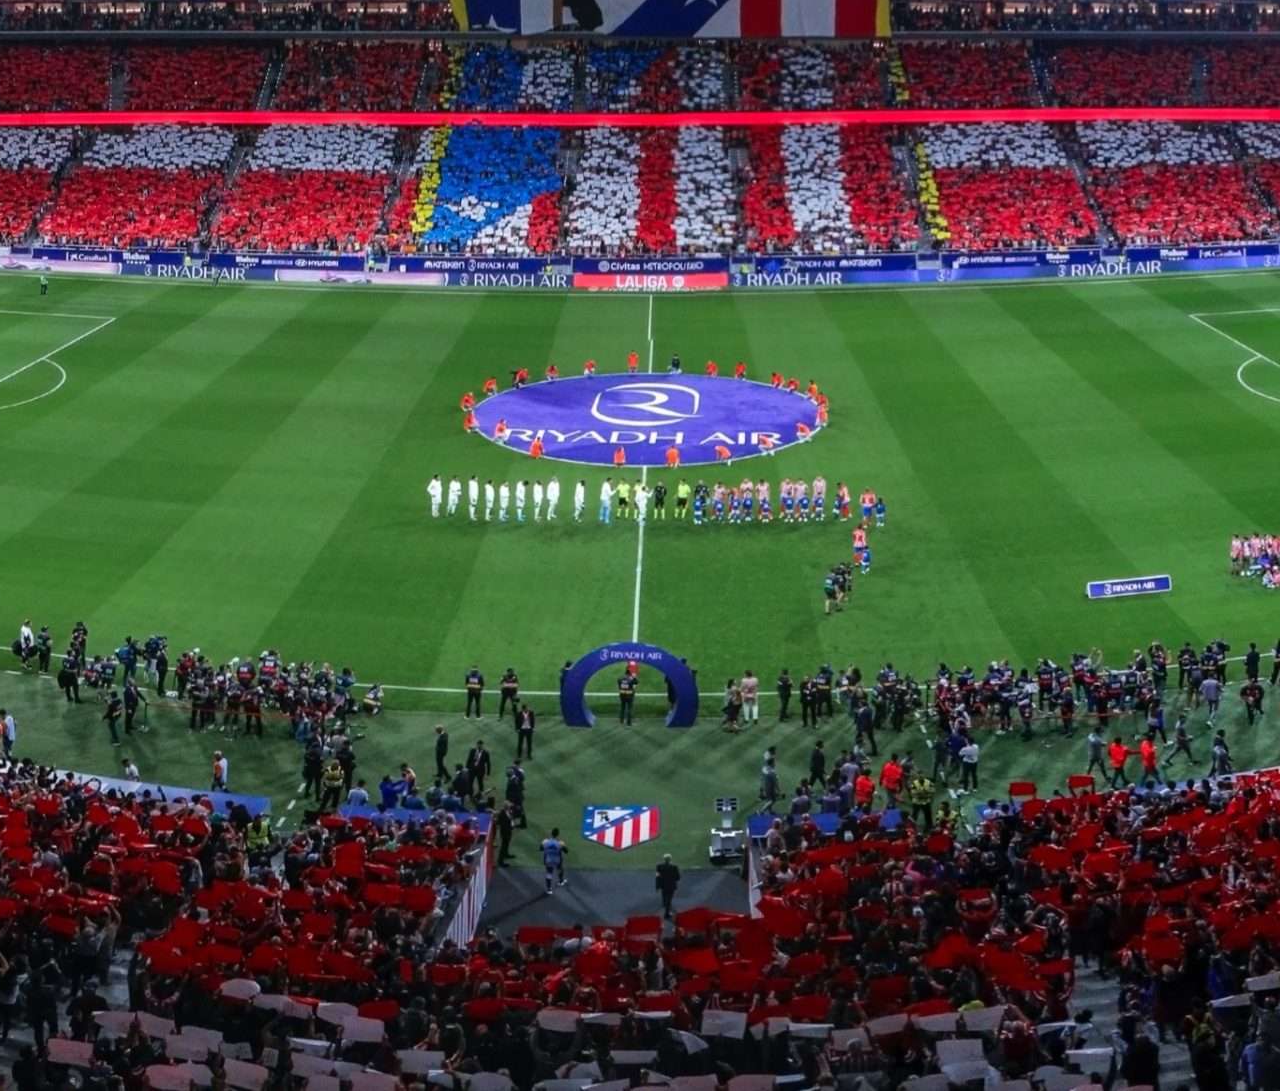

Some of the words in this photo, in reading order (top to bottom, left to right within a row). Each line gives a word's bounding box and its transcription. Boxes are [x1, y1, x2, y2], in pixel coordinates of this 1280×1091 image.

[308, 258, 339, 267] HYUNDAI
[476, 261, 505, 269] RIYADH
[610, 261, 641, 271] Civitas
[1071, 262, 1131, 276] RIYADH
[1135, 261, 1162, 274] AIR
[157, 264, 215, 280] RIYADH
[219, 268, 246, 281] AIR
[747, 273, 809, 286] RIYADH
[814, 272, 842, 286] AIR
[474, 273, 534, 287] RIYADH
[539, 274, 567, 287] AIR
[616, 275, 666, 288] LALIGA
[505, 429, 685, 445] RIYADH
[699, 430, 782, 445] AIR
